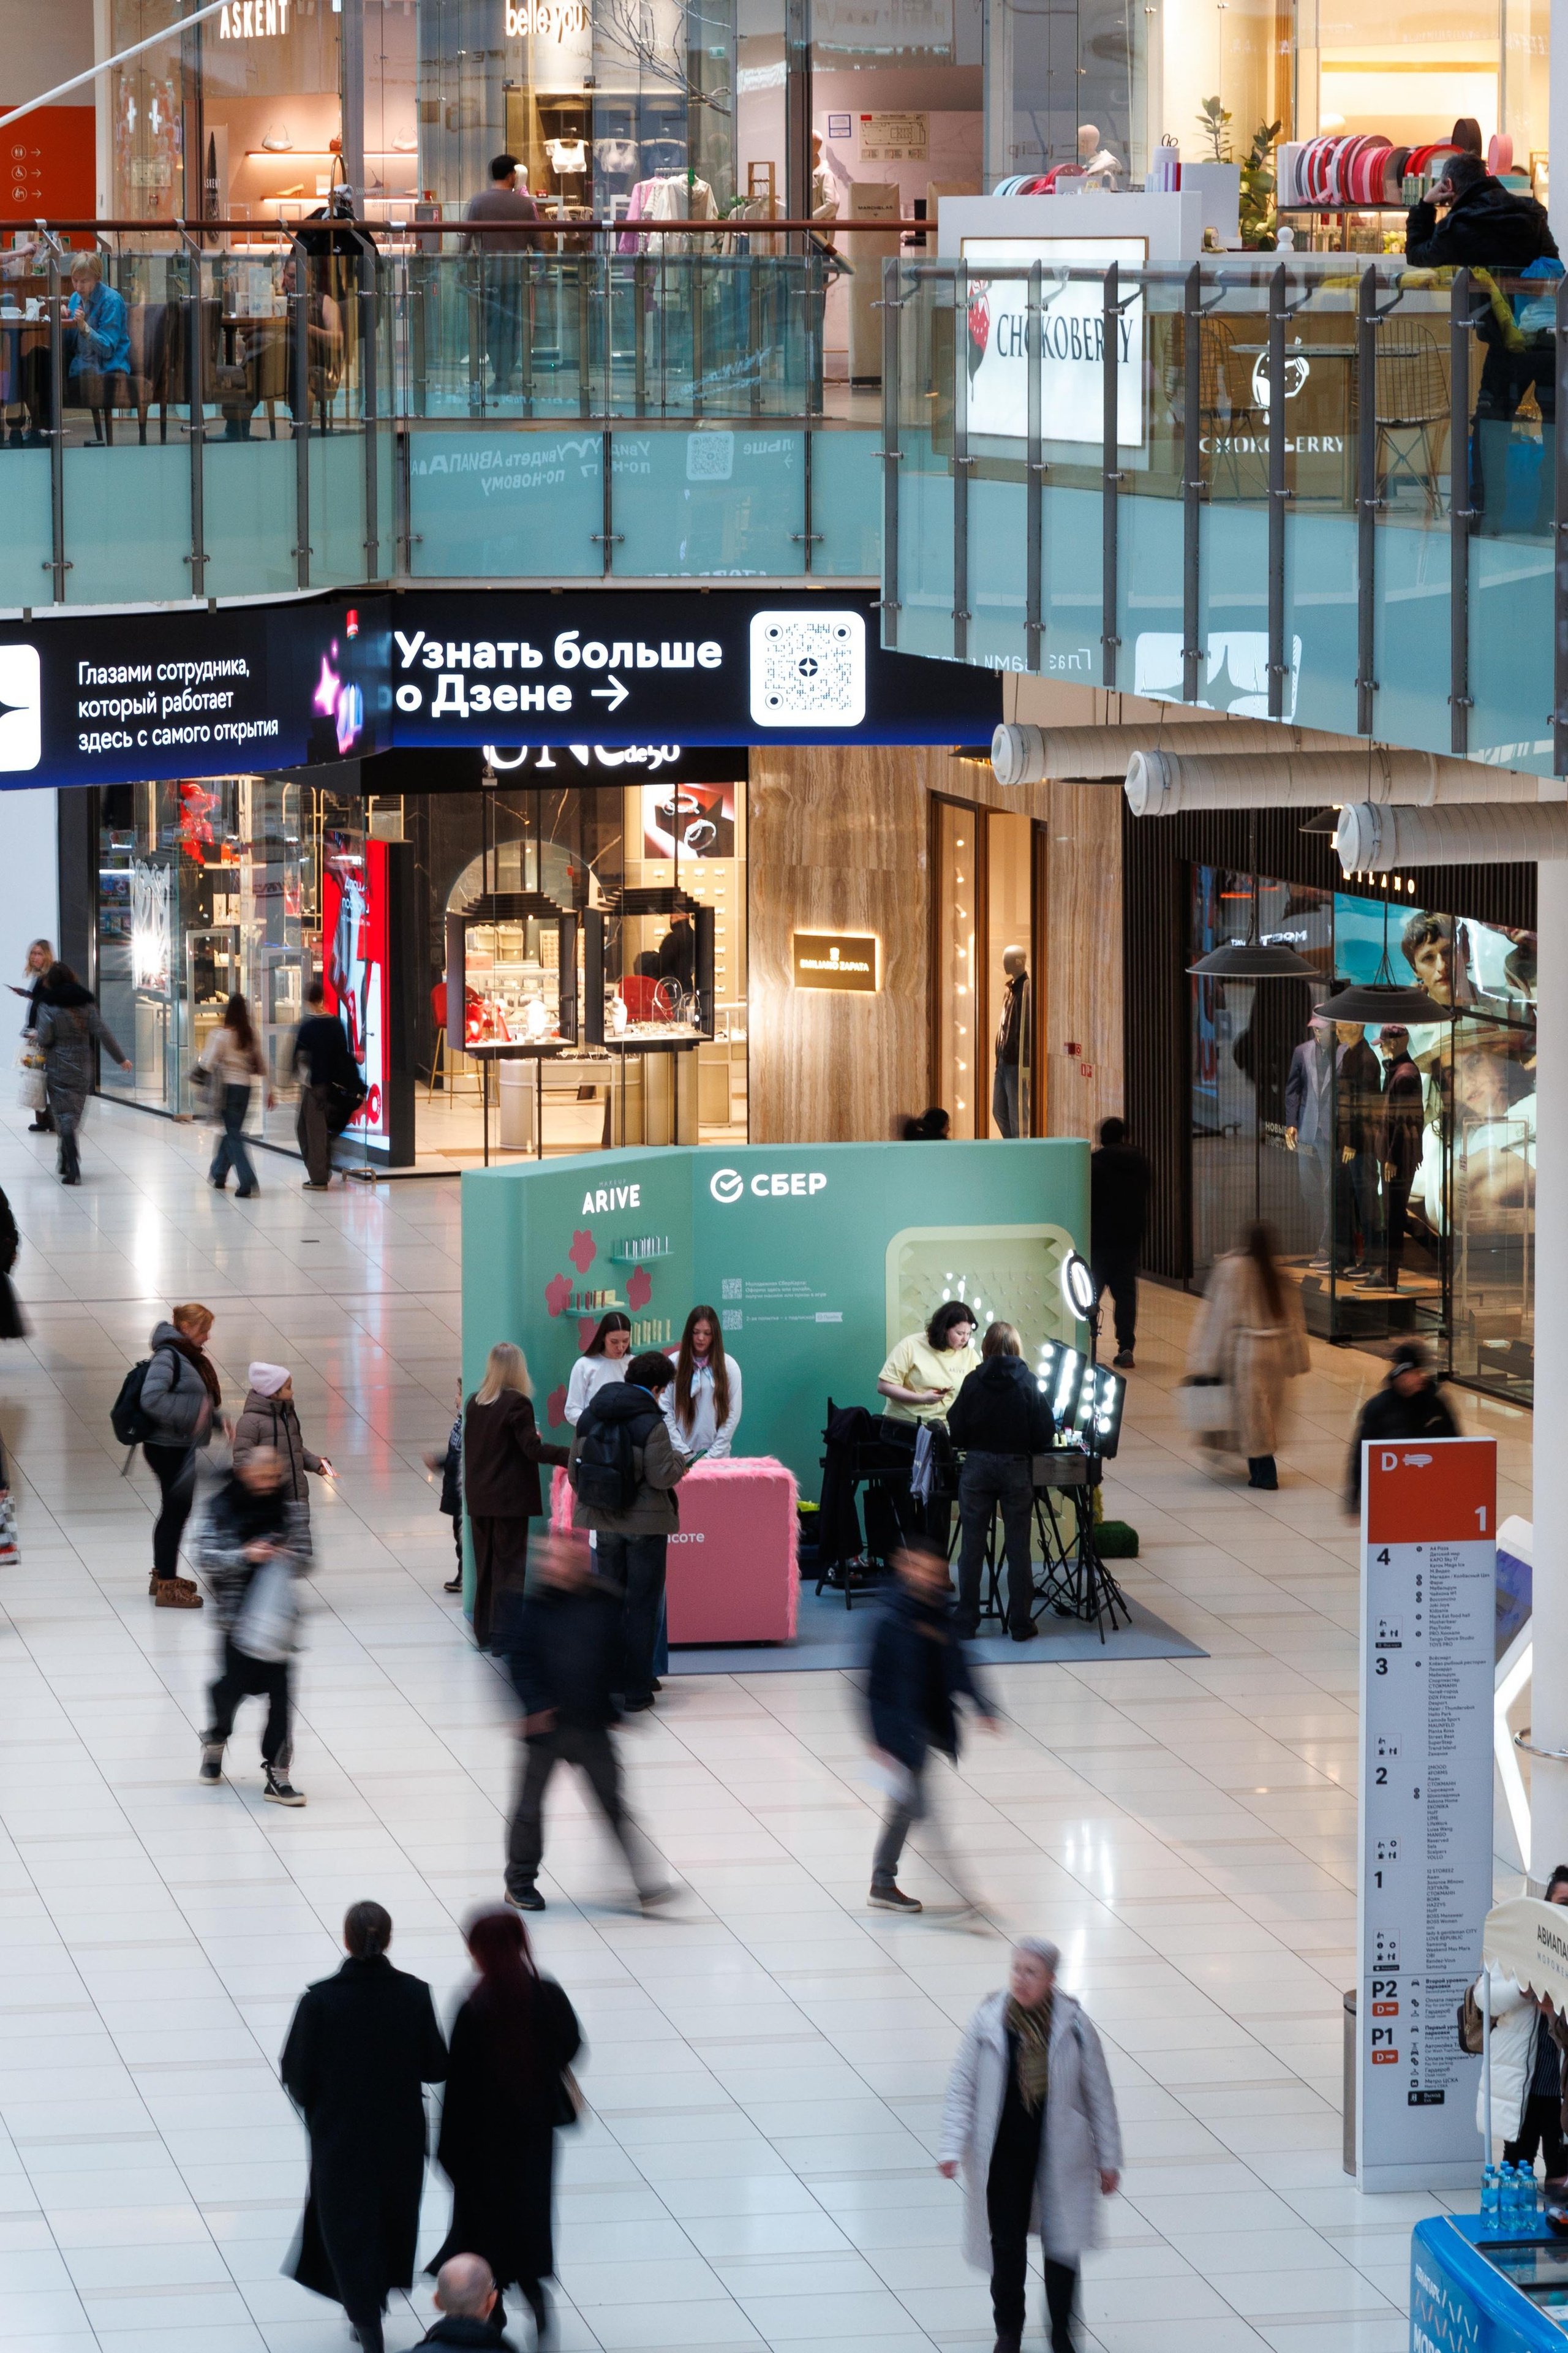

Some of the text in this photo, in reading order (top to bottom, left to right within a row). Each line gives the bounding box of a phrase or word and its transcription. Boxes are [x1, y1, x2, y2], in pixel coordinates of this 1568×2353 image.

[220, 0, 288, 39] ASKENT
[506, 0, 585, 44] belle you
[997, 314, 1134, 363] CHKOBERY
[394, 630, 722, 668] Узнать больше
[78, 658, 250, 686] Глазами сотрудника,
[78, 687, 234, 722] который работает
[396, 674, 573, 718] о Дзене
[78, 719, 278, 754] здесь с самого открытия
[839, 961, 870, 972] ZAPATA
[751, 1173, 827, 1196] СБЕР
[582, 1184, 641, 1215] ARIVE
[1382, 1452, 1398, 1471] D
[1474, 1506, 1487, 1532] 1
[1377, 1547, 1390, 1565] 4
[1376, 1657, 1388, 1675] 3
[1376, 1767, 1387, 1785] 2
[1374, 1871, 1382, 1889] 1
[1537, 1924, 1568, 1960] АВИАПА
[1372, 1980, 1397, 1998] P2
[1377, 2005, 1384, 2014] D
[1372, 2028, 1392, 2045] P1
[1376, 2053, 1384, 2061] D
